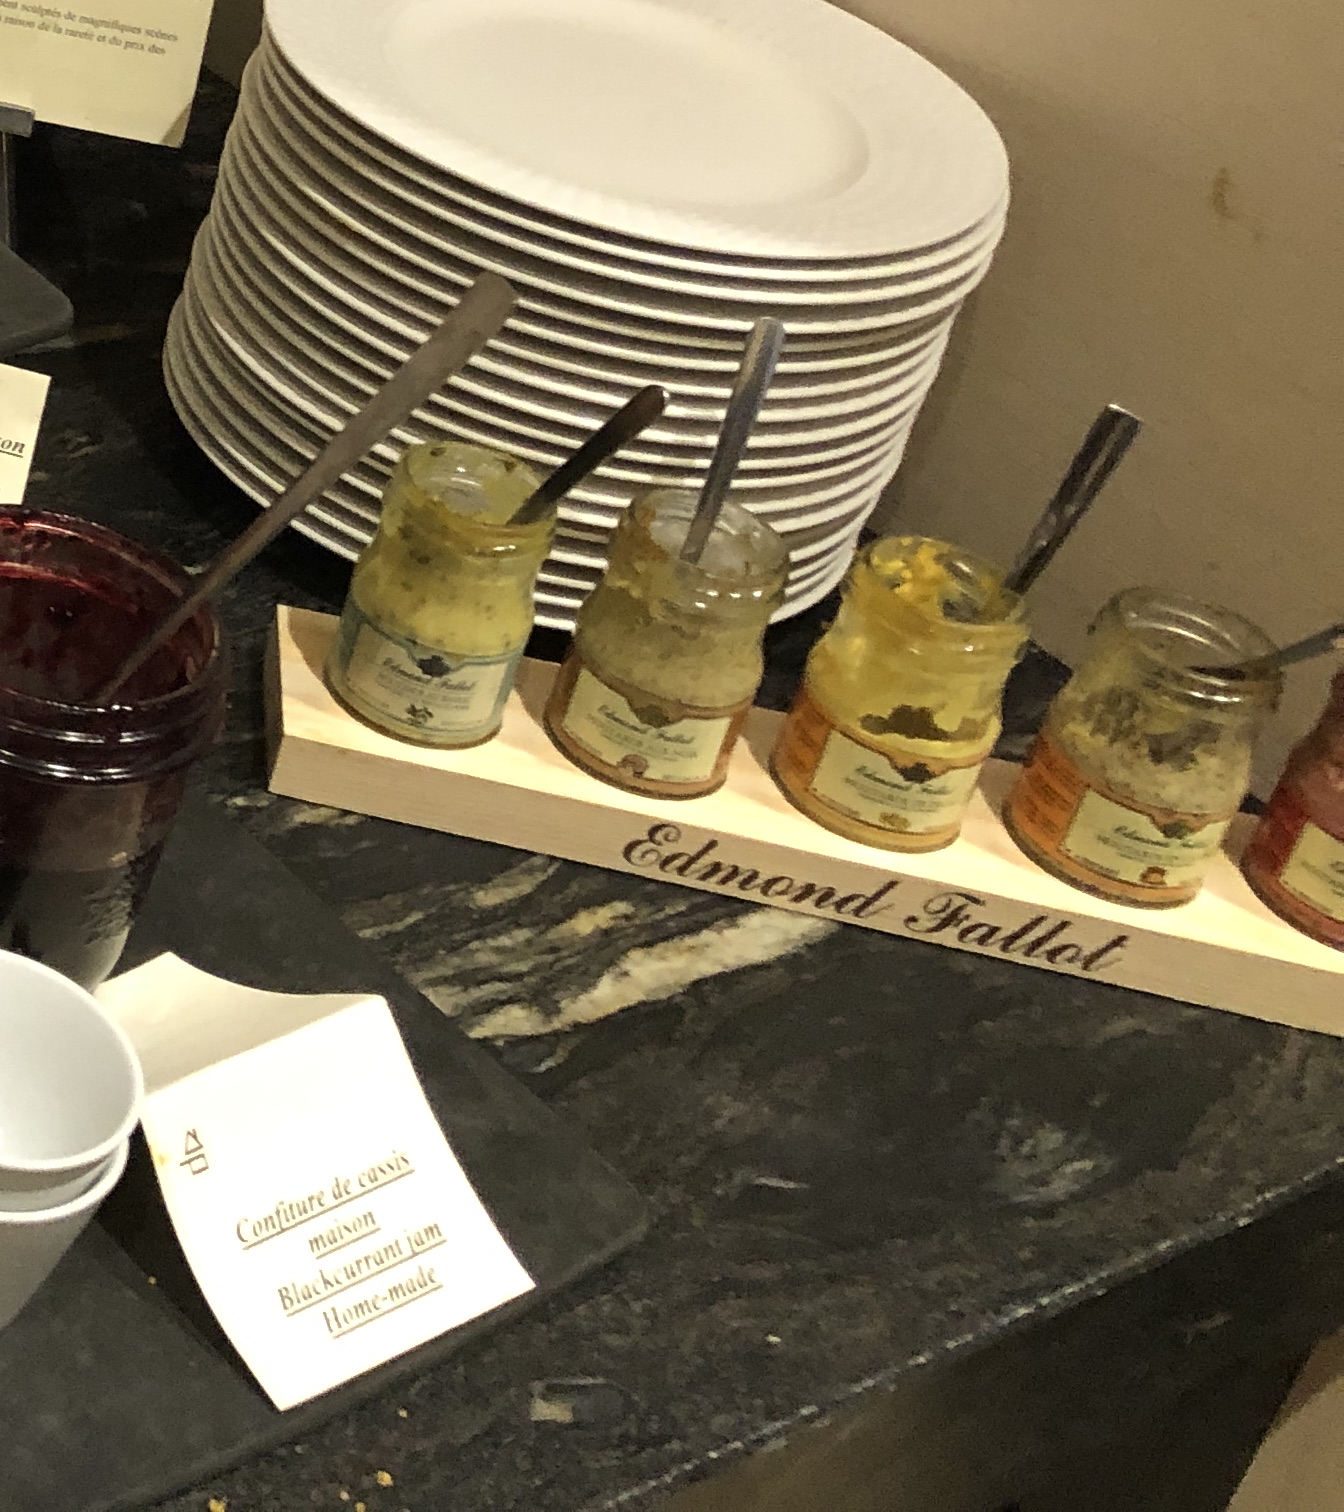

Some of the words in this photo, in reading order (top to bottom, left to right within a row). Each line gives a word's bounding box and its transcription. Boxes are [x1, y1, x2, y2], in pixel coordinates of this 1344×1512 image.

[621, 822, 896, 919] Edmond
[904, 891, 1131, 972] Fallot
[235, 1188, 326, 1244] Confiture
[332, 1176, 353, 1201] de
[357, 1150, 412, 1189] cassis
[308, 1208, 378, 1254] maison
[277, 1238, 404, 1312] Blackcurrant
[406, 1220, 444, 1258] jam
[323, 1263, 438, 1334] Home-made
